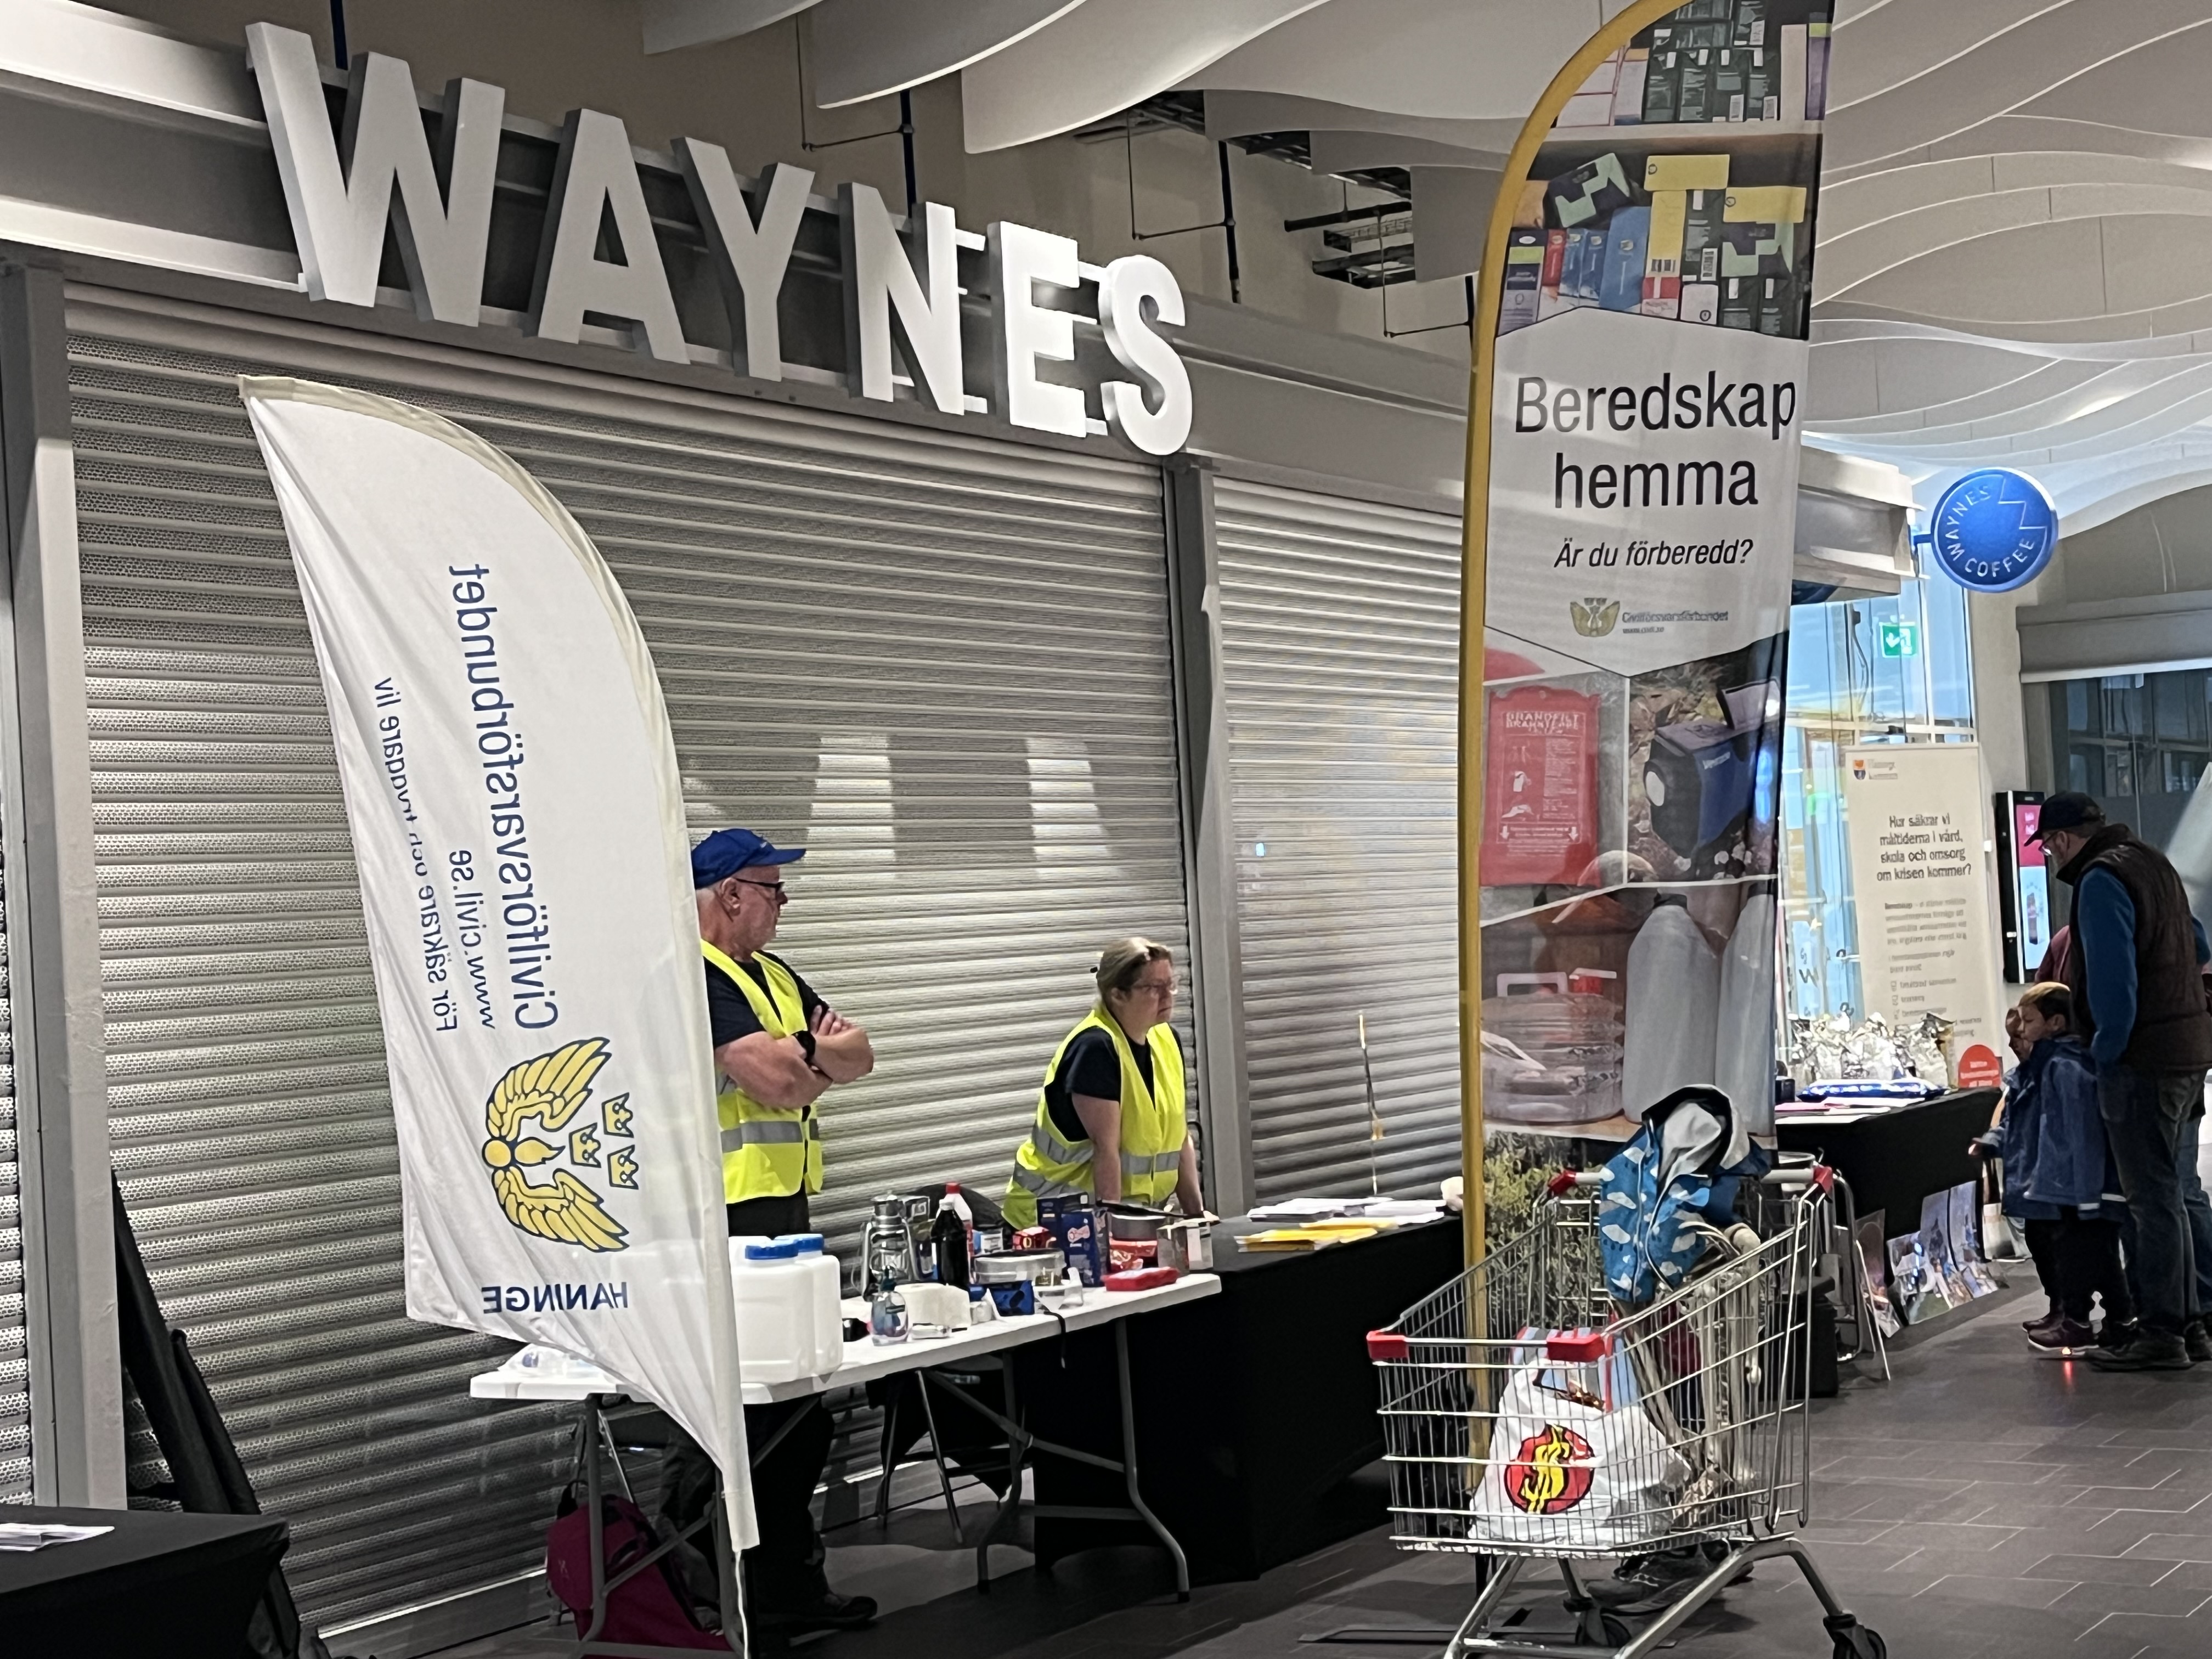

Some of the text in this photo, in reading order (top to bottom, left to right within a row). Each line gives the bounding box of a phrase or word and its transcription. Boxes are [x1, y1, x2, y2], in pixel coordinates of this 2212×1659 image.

[245, 22, 1193, 455] WAYNES
[1515, 370, 1796, 441] Beredskap
[1554, 453, 1759, 509] hemma
[1945, 485, 1991, 561] WAYNES
[1554, 537, 1754, 568] Är du förberedd?
[1965, 538, 2035, 577] COFFEE
[1877, 870, 1892, 882] om
[1908, 849, 1927, 862] och
[1929, 848, 1966, 861] omsorg
